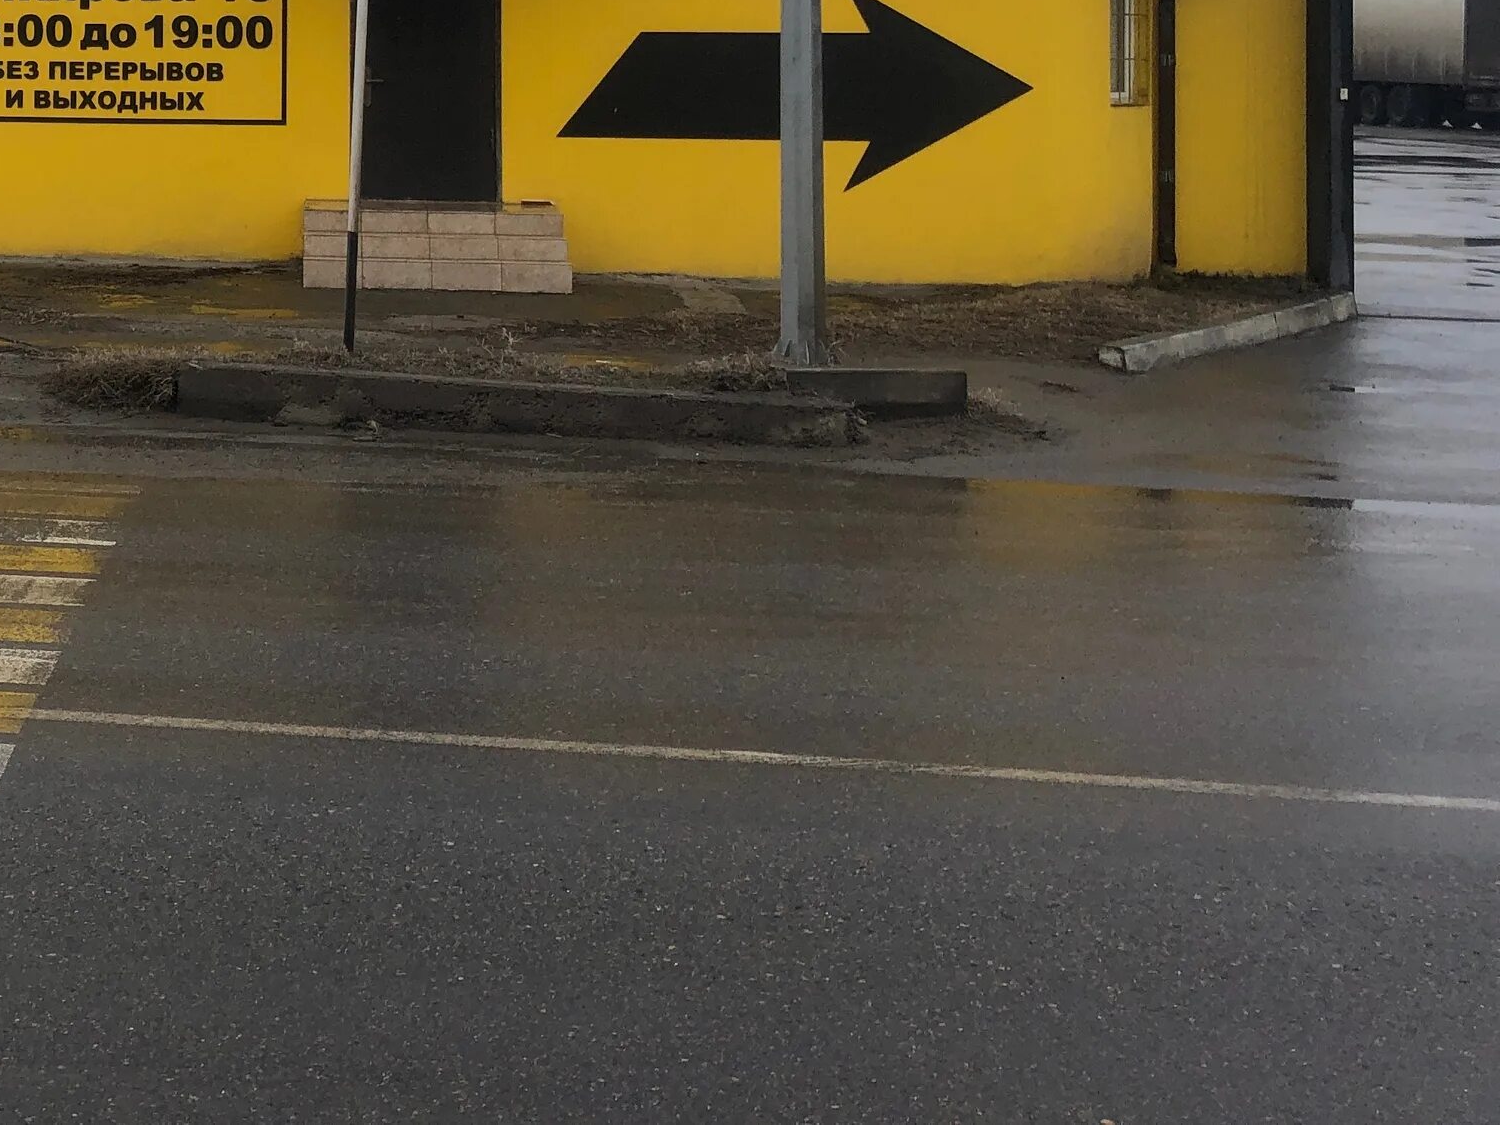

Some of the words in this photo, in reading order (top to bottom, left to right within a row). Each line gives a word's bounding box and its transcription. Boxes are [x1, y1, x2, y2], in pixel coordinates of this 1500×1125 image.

[80, 24, 137, 50] до
[144, 15, 273, 49] 19:00
[48, 61, 224, 82] ПЕРЕРЫВОВ
[5, 90, 23, 108] И
[34, 90, 205, 113] ВЫХОДНЫХ
